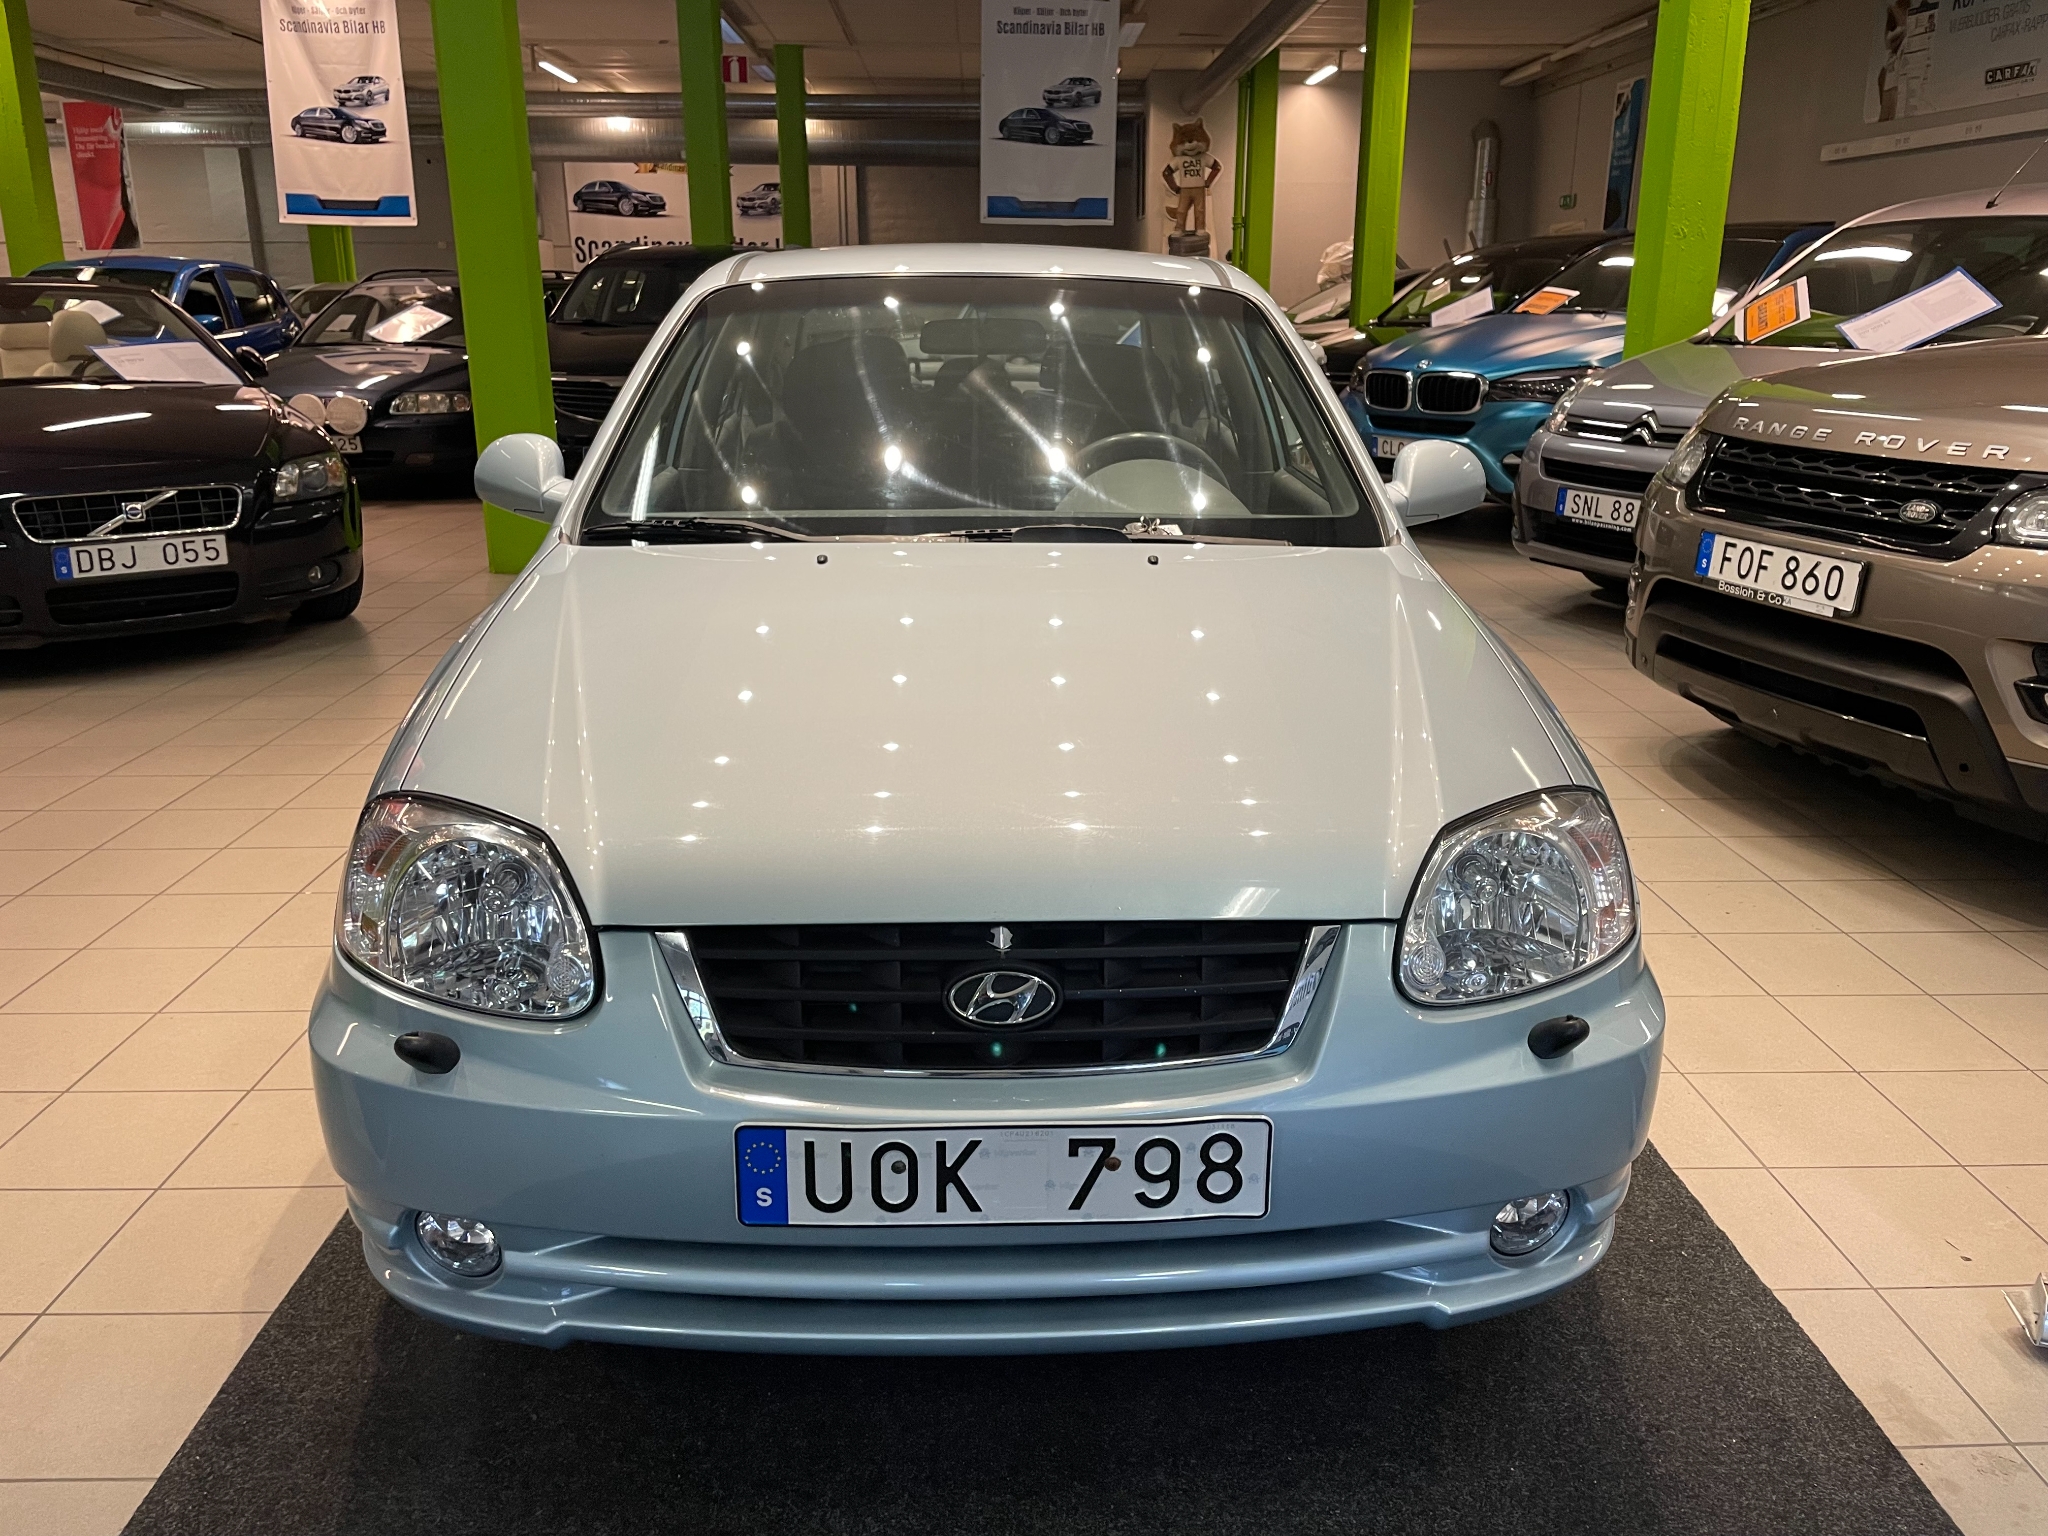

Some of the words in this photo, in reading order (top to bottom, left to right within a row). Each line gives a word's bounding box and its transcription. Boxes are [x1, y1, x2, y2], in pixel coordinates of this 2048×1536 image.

[280, 19, 340, 34] Scandinavia
[343, 20, 370, 34] Bilar
[372, 20, 386, 34] HB
[997, 20, 1062, 35] Scandinavia
[1064, 21, 1089, 36] Bilar
[1091, 22, 1105, 36] HB
[1986, 60, 2037, 83] CARFAX
[1182, 160, 1202, 169] CAR
[1184, 169, 1201, 178] FOX
[1733, 416, 1833, 442] RANGE
[1854, 431, 2010, 460] ROVER
[1571, 494, 1602, 519] SNL
[75, 545, 137, 574] DBJ
[162, 538, 220, 566] 055
[1701, 558, 1708, 568] S
[1719, 541, 1774, 583] FOF
[1781, 555, 1845, 601] 860
[1757, 590, 1766, 601] &
[1768, 592, 1782, 605] Co
[803, 1139, 983, 1213] UOK
[1067, 1132, 1243, 1212] 798
[755, 1186, 773, 1208] S
